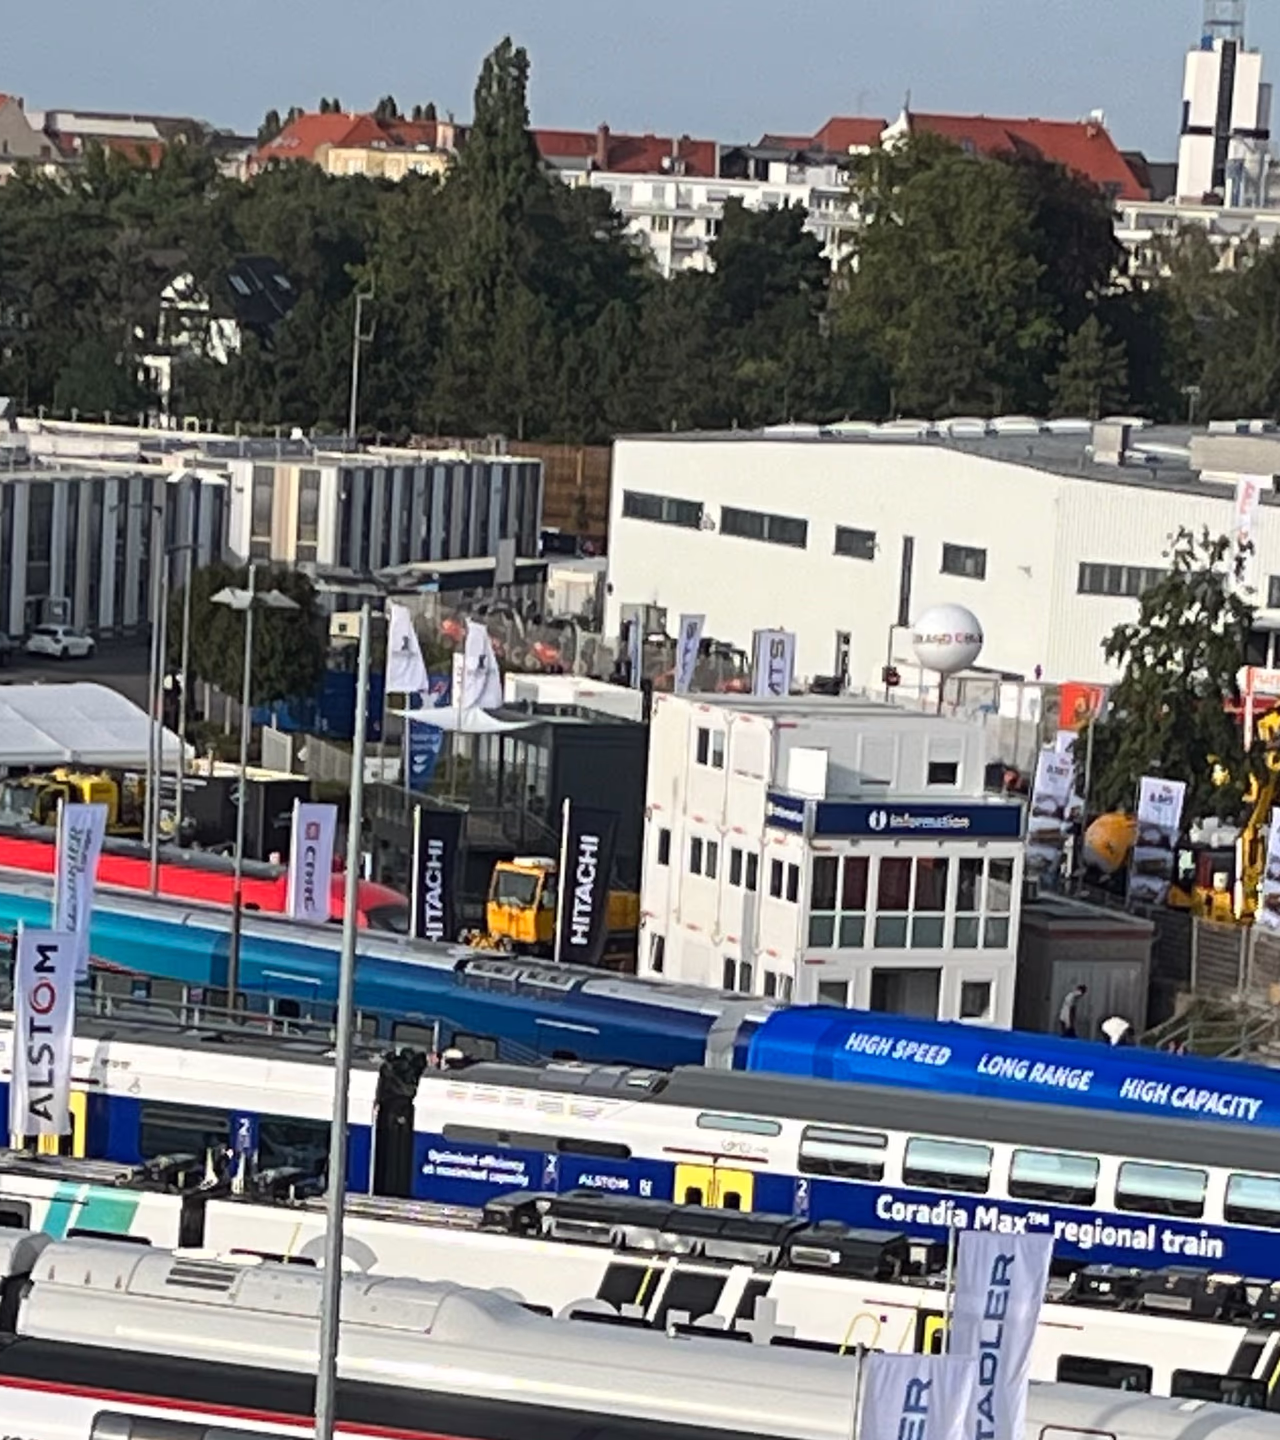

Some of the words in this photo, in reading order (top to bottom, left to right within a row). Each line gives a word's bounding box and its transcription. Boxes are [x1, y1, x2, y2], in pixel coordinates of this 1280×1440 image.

[569, 834, 600, 945] HITACHI
[27, 943, 59, 1122] ALSTOM
[844, 1032, 894, 1057] HIGH
[893, 1038, 952, 1066] SPEED
[976, 1051, 1029, 1081] LONG
[1028, 1061, 1095, 1092] RANGE
[1119, 1076, 1171, 1107] HIGH
[1170, 1085, 1263, 1122] CAPACITY
[237, 1116, 252, 1137] 2
[876, 1193, 969, 1230] Coradia
[1053, 1218, 1155, 1252] regional
[1160, 1228, 1224, 1260] train
